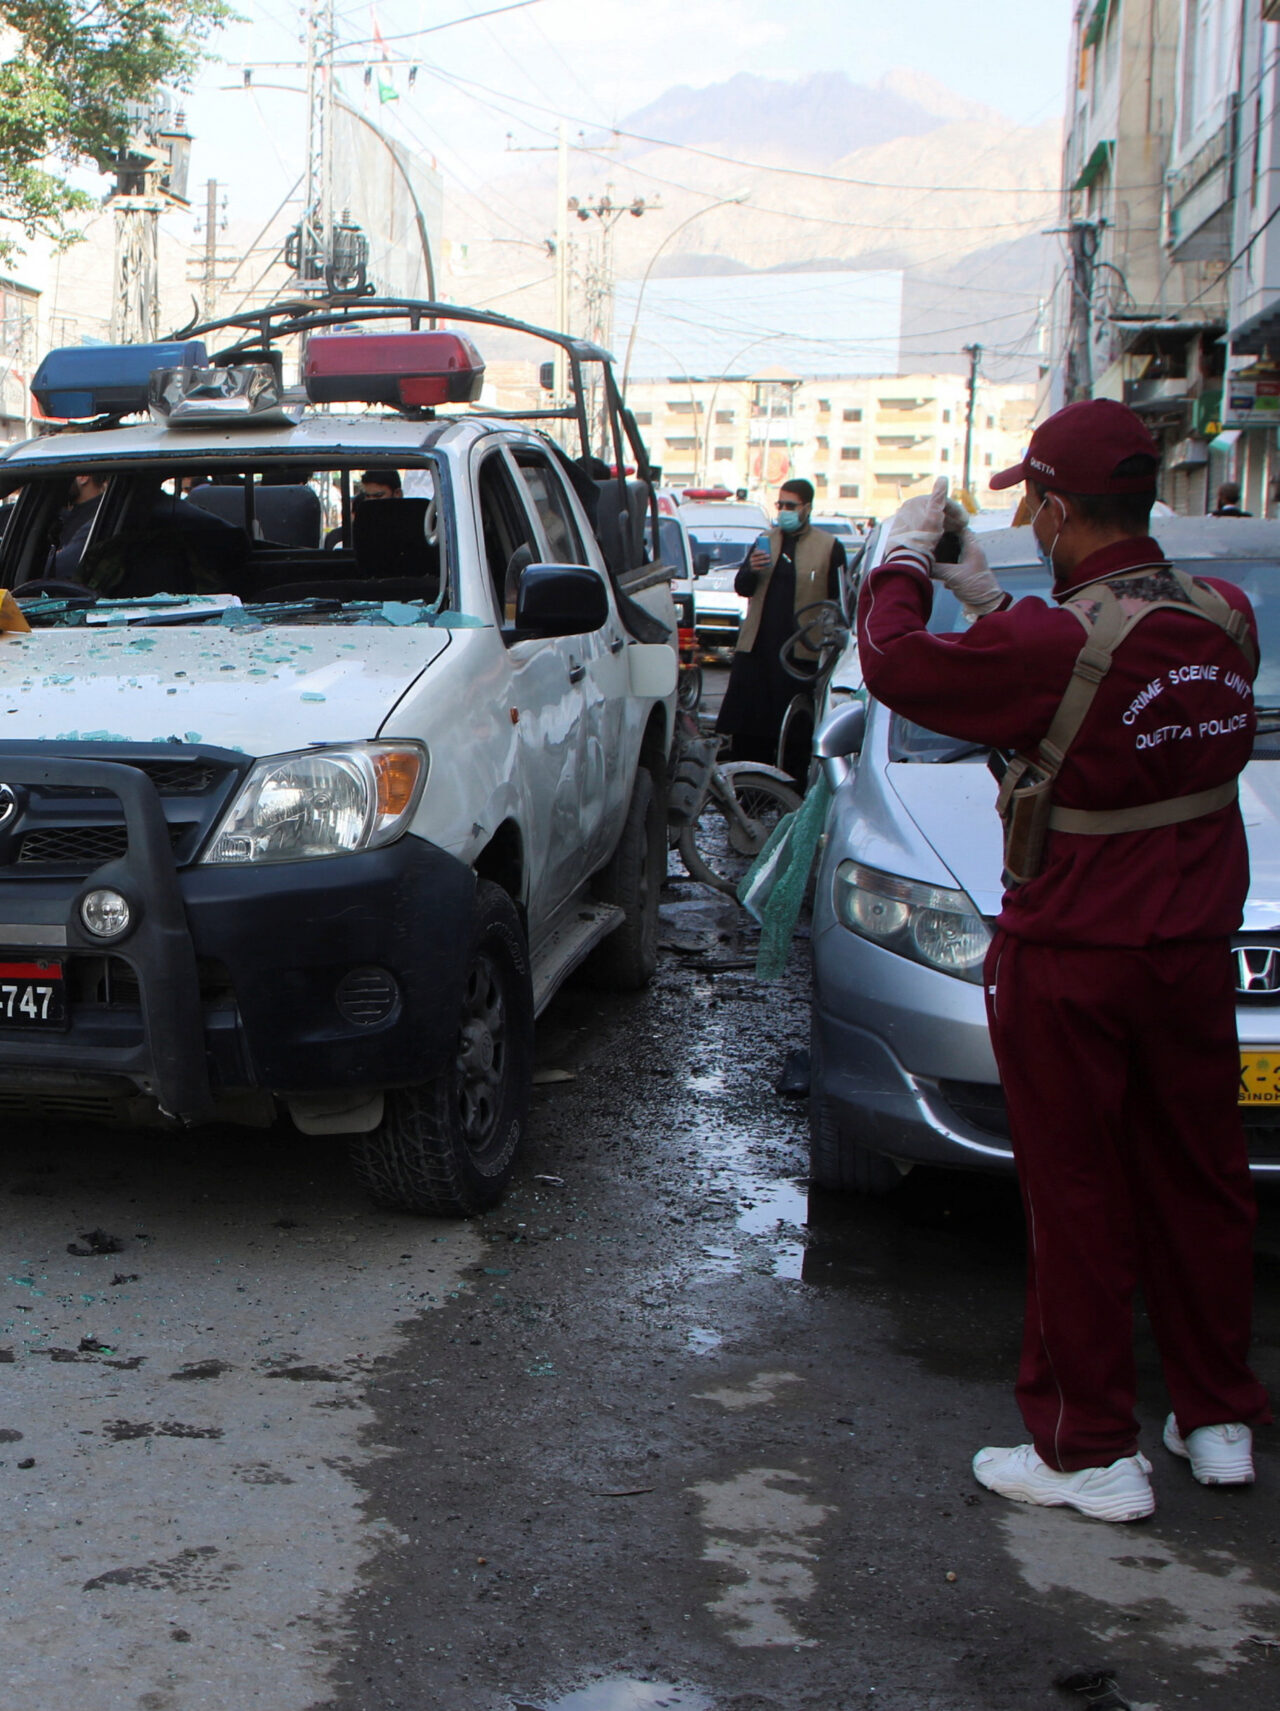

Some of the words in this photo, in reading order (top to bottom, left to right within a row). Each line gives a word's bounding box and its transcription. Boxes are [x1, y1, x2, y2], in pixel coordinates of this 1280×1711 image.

[1030, 456, 1055, 477] QUETTA
[1122, 677, 1164, 725] CRIME
[1168, 665, 1219, 684] SCENE
[1224, 670, 1251, 699] UNIT
[1135, 725, 1192, 749] QUETTA
[1199, 713, 1248, 738] POLICE
